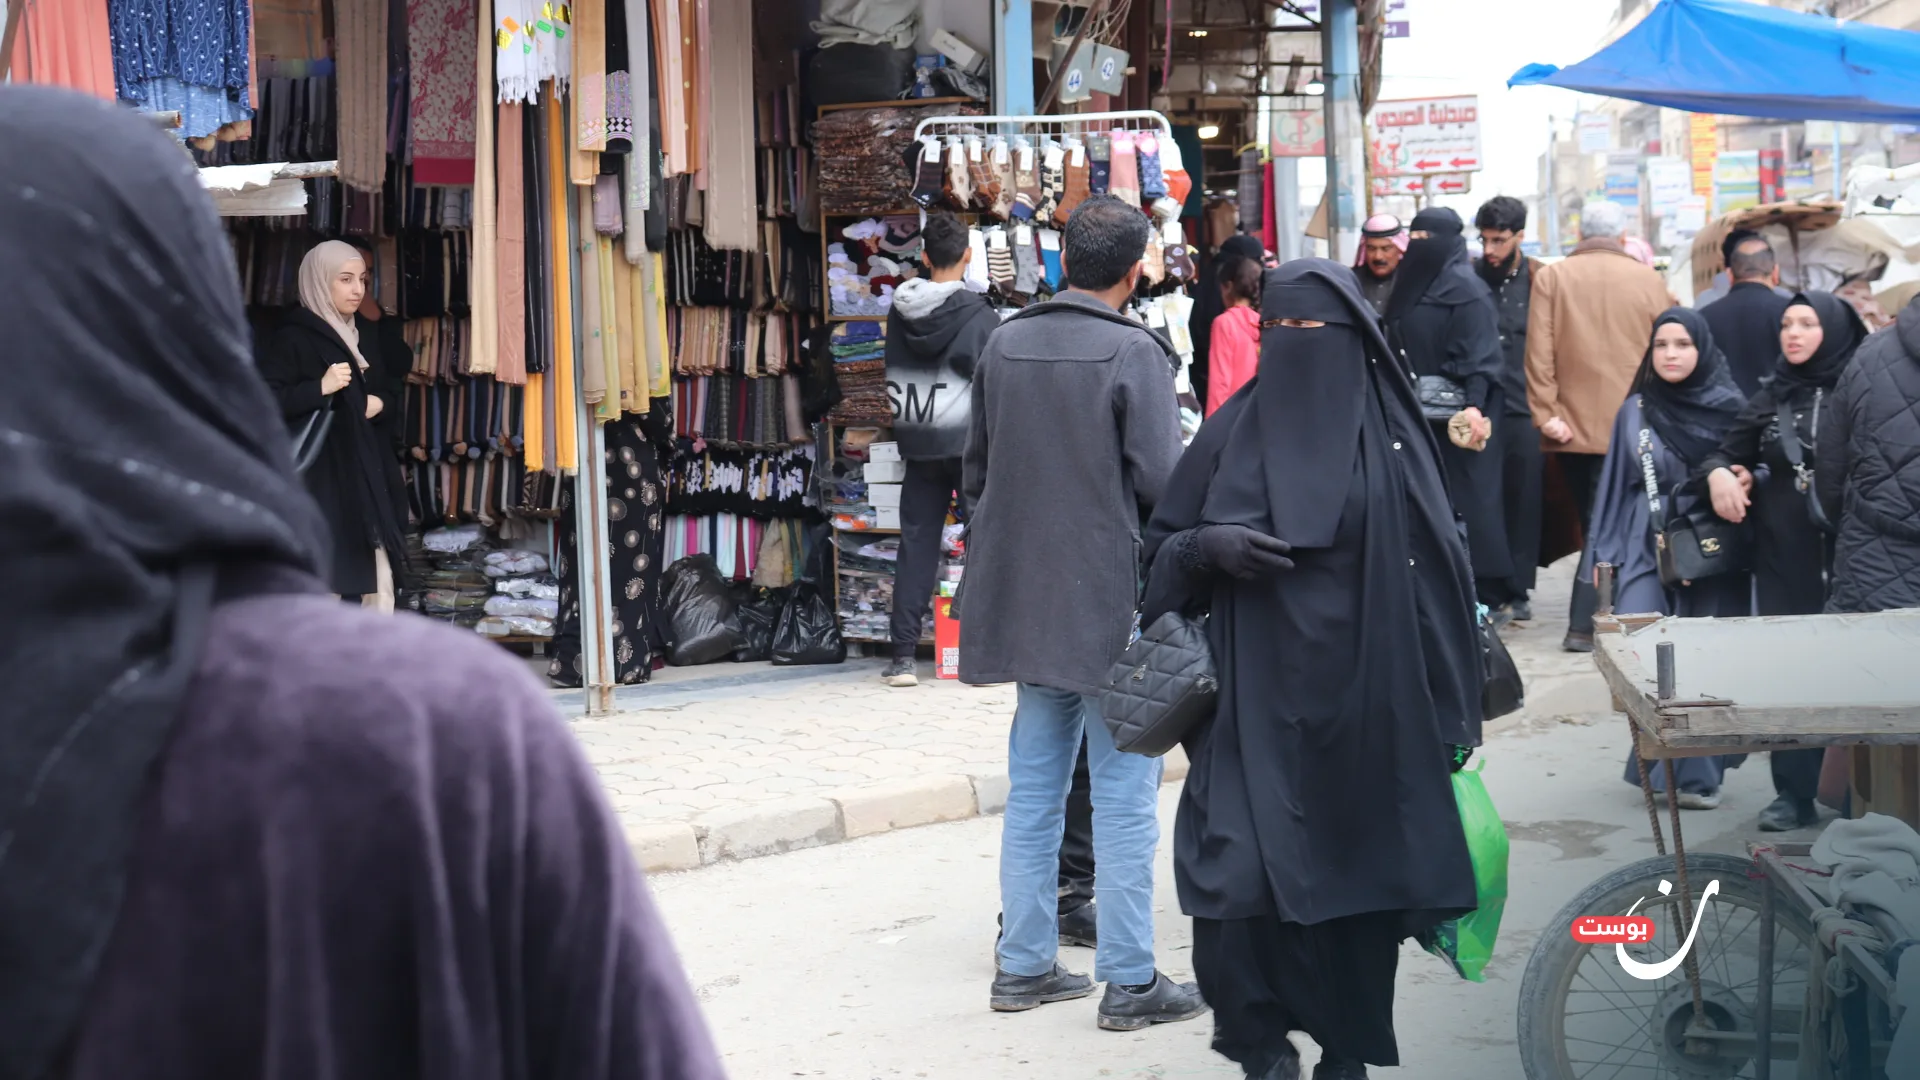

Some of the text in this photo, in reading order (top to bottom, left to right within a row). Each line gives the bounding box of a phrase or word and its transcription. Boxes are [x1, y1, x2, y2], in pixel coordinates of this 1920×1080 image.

[1102, 62, 1114, 77] 42
[1068, 75, 1081, 89] 44
[1429, 103, 1477, 130] صيدلية
[1641, 452, 1659, 499] CHANEL
